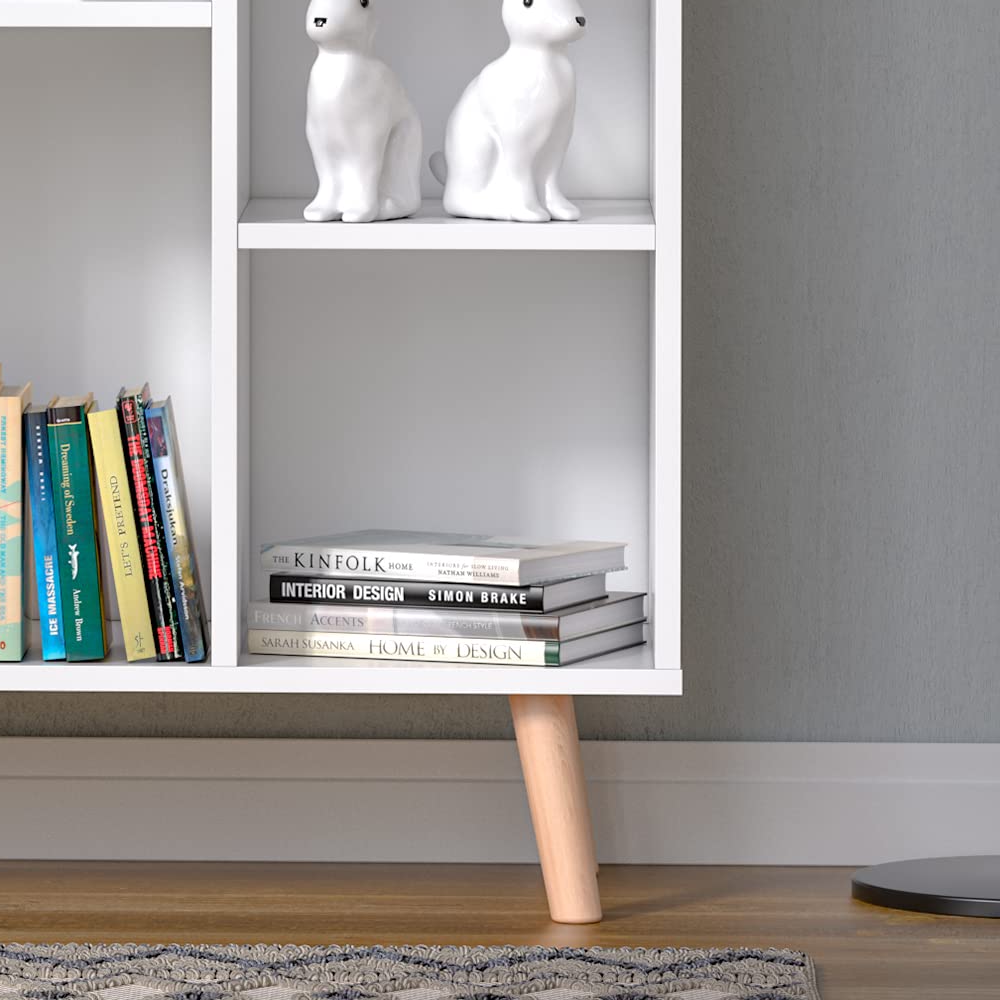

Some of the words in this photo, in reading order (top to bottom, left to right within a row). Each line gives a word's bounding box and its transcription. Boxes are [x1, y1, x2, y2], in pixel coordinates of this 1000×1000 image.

[127, 434, 142, 457] THE
[59, 443, 73, 488] Dreaming
[64, 489, 74, 500] of
[131, 458, 153, 522] DOOMSDAY
[64, 500, 76, 536] Sweden
[109, 475, 126, 536] PRETEND
[161, 468, 178, 545] Draksjukan
[120, 541, 133, 577] LET'S
[143, 526, 162, 580] MACHINE
[294, 552, 386, 572] KINFOLK
[388, 562, 413, 570] HOME
[43, 554, 57, 615] MASSACRE
[281, 582, 346, 599] INTERIOR
[353, 585, 404, 602] DESIGN
[428, 589, 473, 603] SIMON
[480, 591, 527, 605] BRAKE
[72, 589, 82, 616] Andrew
[179, 581, 189, 620] Arvidsson
[48, 617, 59, 636] ICE
[74, 618, 84, 642] Brown
[254, 610, 302, 625] FRENCH
[310, 613, 365, 627] ACCENTS
[261, 637, 299, 648] SARAH
[302, 638, 355, 651] SUSANKA
[369, 639, 425, 656] HOME
[433, 644, 447, 655] BY
[457, 643, 522, 660] DESIGN
